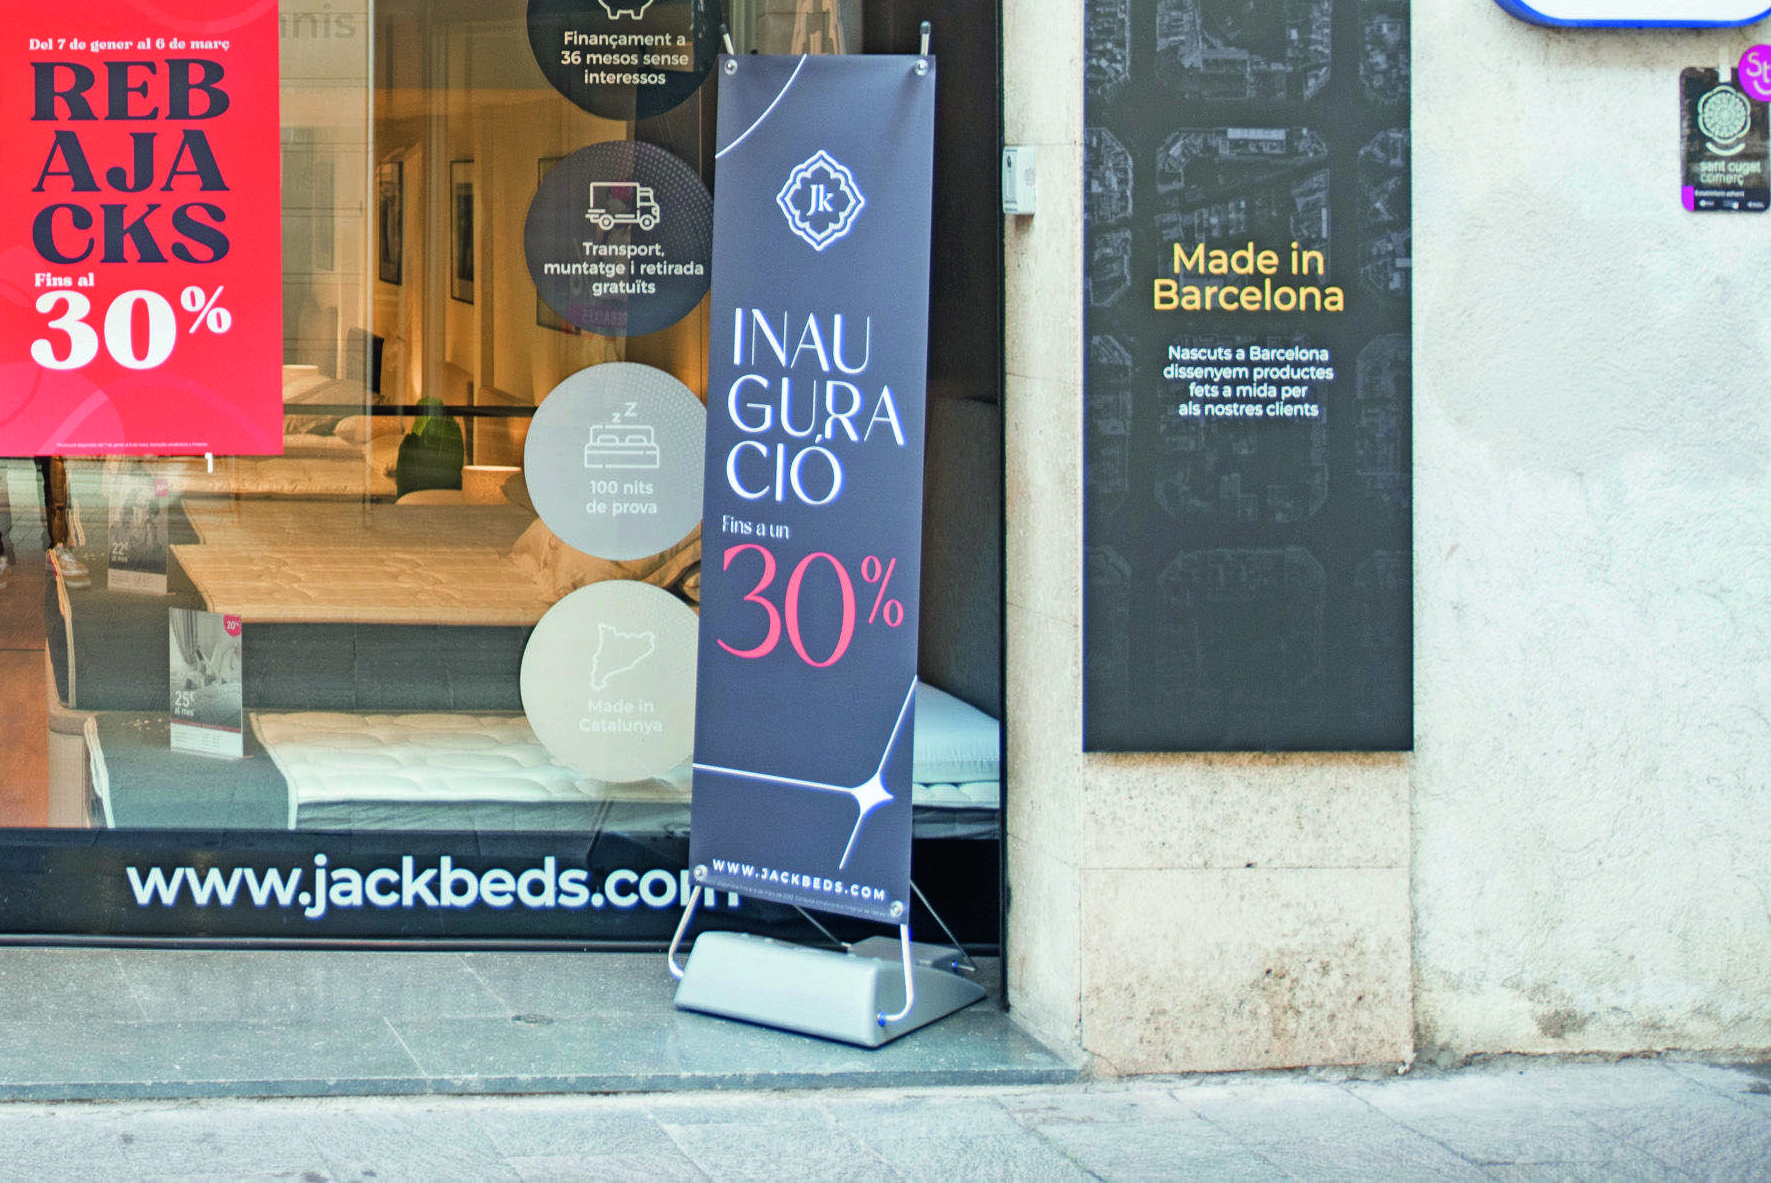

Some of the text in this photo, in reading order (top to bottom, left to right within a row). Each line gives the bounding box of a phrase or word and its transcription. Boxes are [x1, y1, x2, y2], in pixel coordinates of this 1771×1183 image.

[29, 37, 230, 53] Del 7 de gener al 6 de març
[563, 30, 687, 50] Finançament a
[560, 50, 689, 66] 36 mesos sense
[584, 69, 667, 85] interessos
[30, 58, 231, 122] REB
[32, 128, 231, 194] AJA
[806, 184, 834, 217] Jk
[32, 201, 231, 265] CKS
[582, 242, 665, 259] Transport,
[1173, 241, 1325, 276] Made in
[543, 261, 704, 278] muntatge i retirada
[34, 271, 95, 288] Fins al
[591, 279, 657, 297] gratuïts
[1153, 277, 1345, 312] Barcelona
[30, 283, 234, 372] 30%
[733, 307, 871, 375] INAU
[1167, 345, 1329, 362] Nascuts a Barcelona
[1163, 364, 1334, 382] dissenyem productes
[1189, 382, 1309, 401] fets a mida per
[727, 374, 906, 446] GURA
[1178, 401, 1320, 417] als nostres clients
[726, 433, 844, 506] CIÓ
[589, 480, 655, 495] 100 nits
[586, 499, 658, 518] de prova
[722, 515, 790, 539] Fins a un
[717, 543, 905, 669] 30%
[588, 698, 655, 714] Made in
[579, 718, 664, 736] Catalunya
[712, 858, 887, 902] WWW.JACKBEDS.COM
